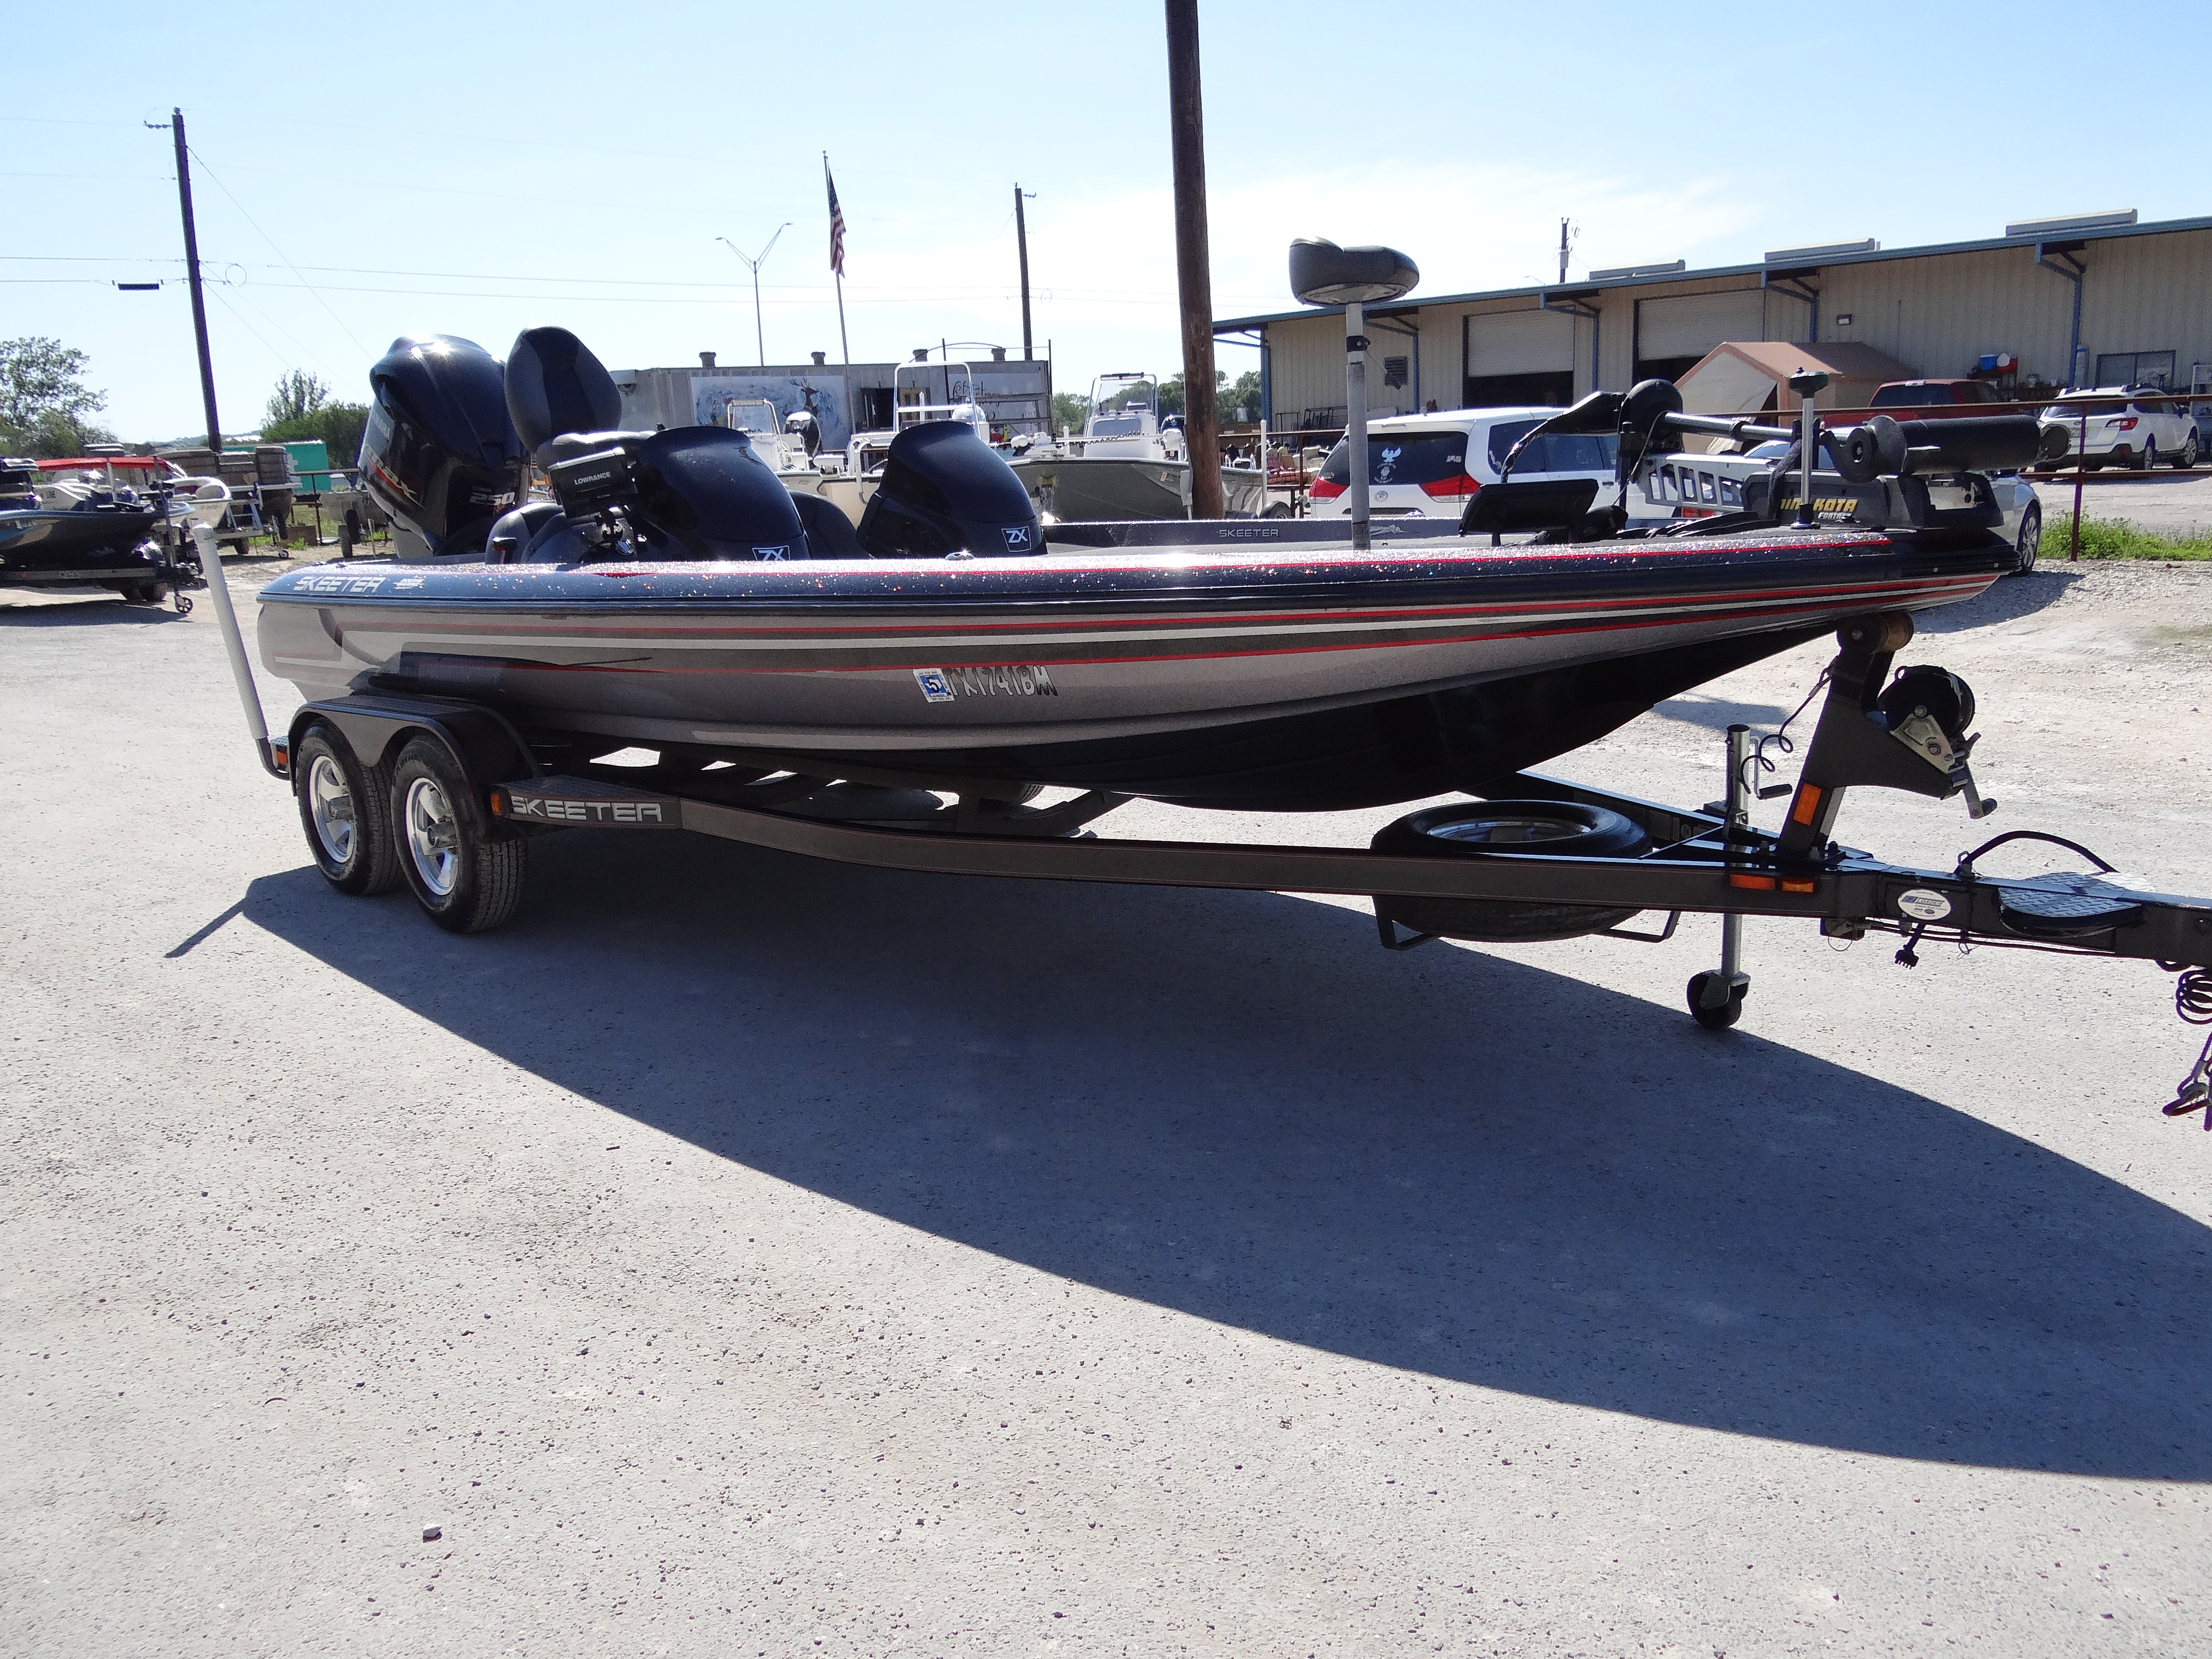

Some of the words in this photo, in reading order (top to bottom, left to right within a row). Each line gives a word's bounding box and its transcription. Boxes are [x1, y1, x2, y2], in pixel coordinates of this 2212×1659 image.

[574, 471, 611, 485] LOWRANCE
[469, 492, 516, 506] 250
[1813, 498, 1858, 512] KOTA
[1006, 529, 1028, 543] ZX
[1219, 529, 1279, 537] SKEETER
[293, 576, 386, 593] SKEETER
[926, 676, 940, 693] 5
[511, 796, 662, 822] SKEETER
